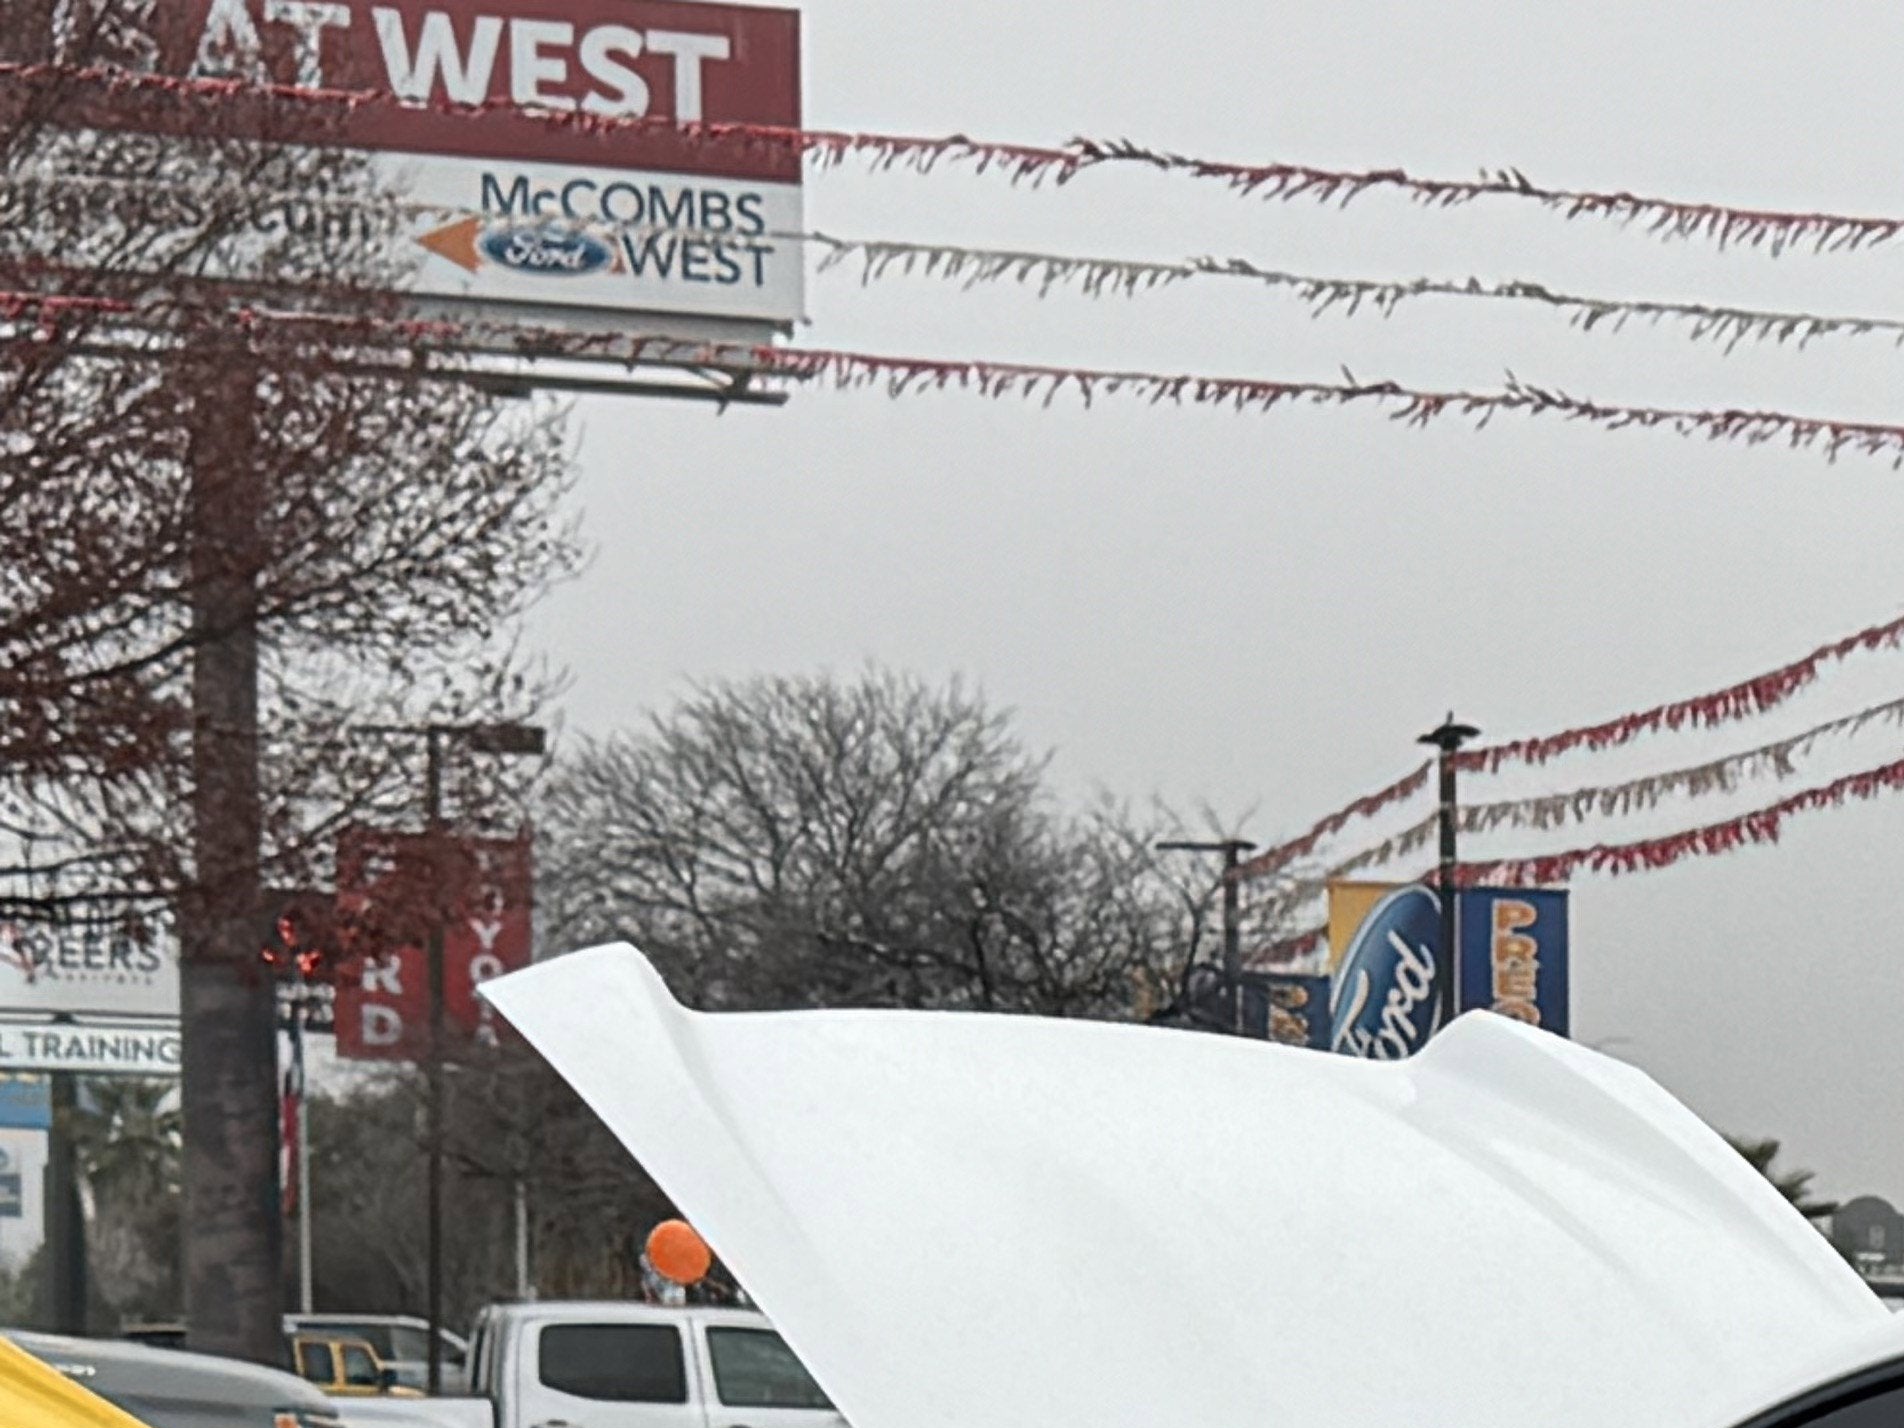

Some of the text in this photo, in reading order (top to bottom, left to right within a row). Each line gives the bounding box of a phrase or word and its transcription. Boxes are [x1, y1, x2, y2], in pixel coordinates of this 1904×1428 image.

[187, 0, 351, 90] AT
[372, 7, 730, 130] WEST
[480, 172, 767, 237] McCOMBS
[504, 234, 586, 271] Ford
[621, 233, 775, 287] WEST
[23, 1031, 181, 1063] TRAINING
